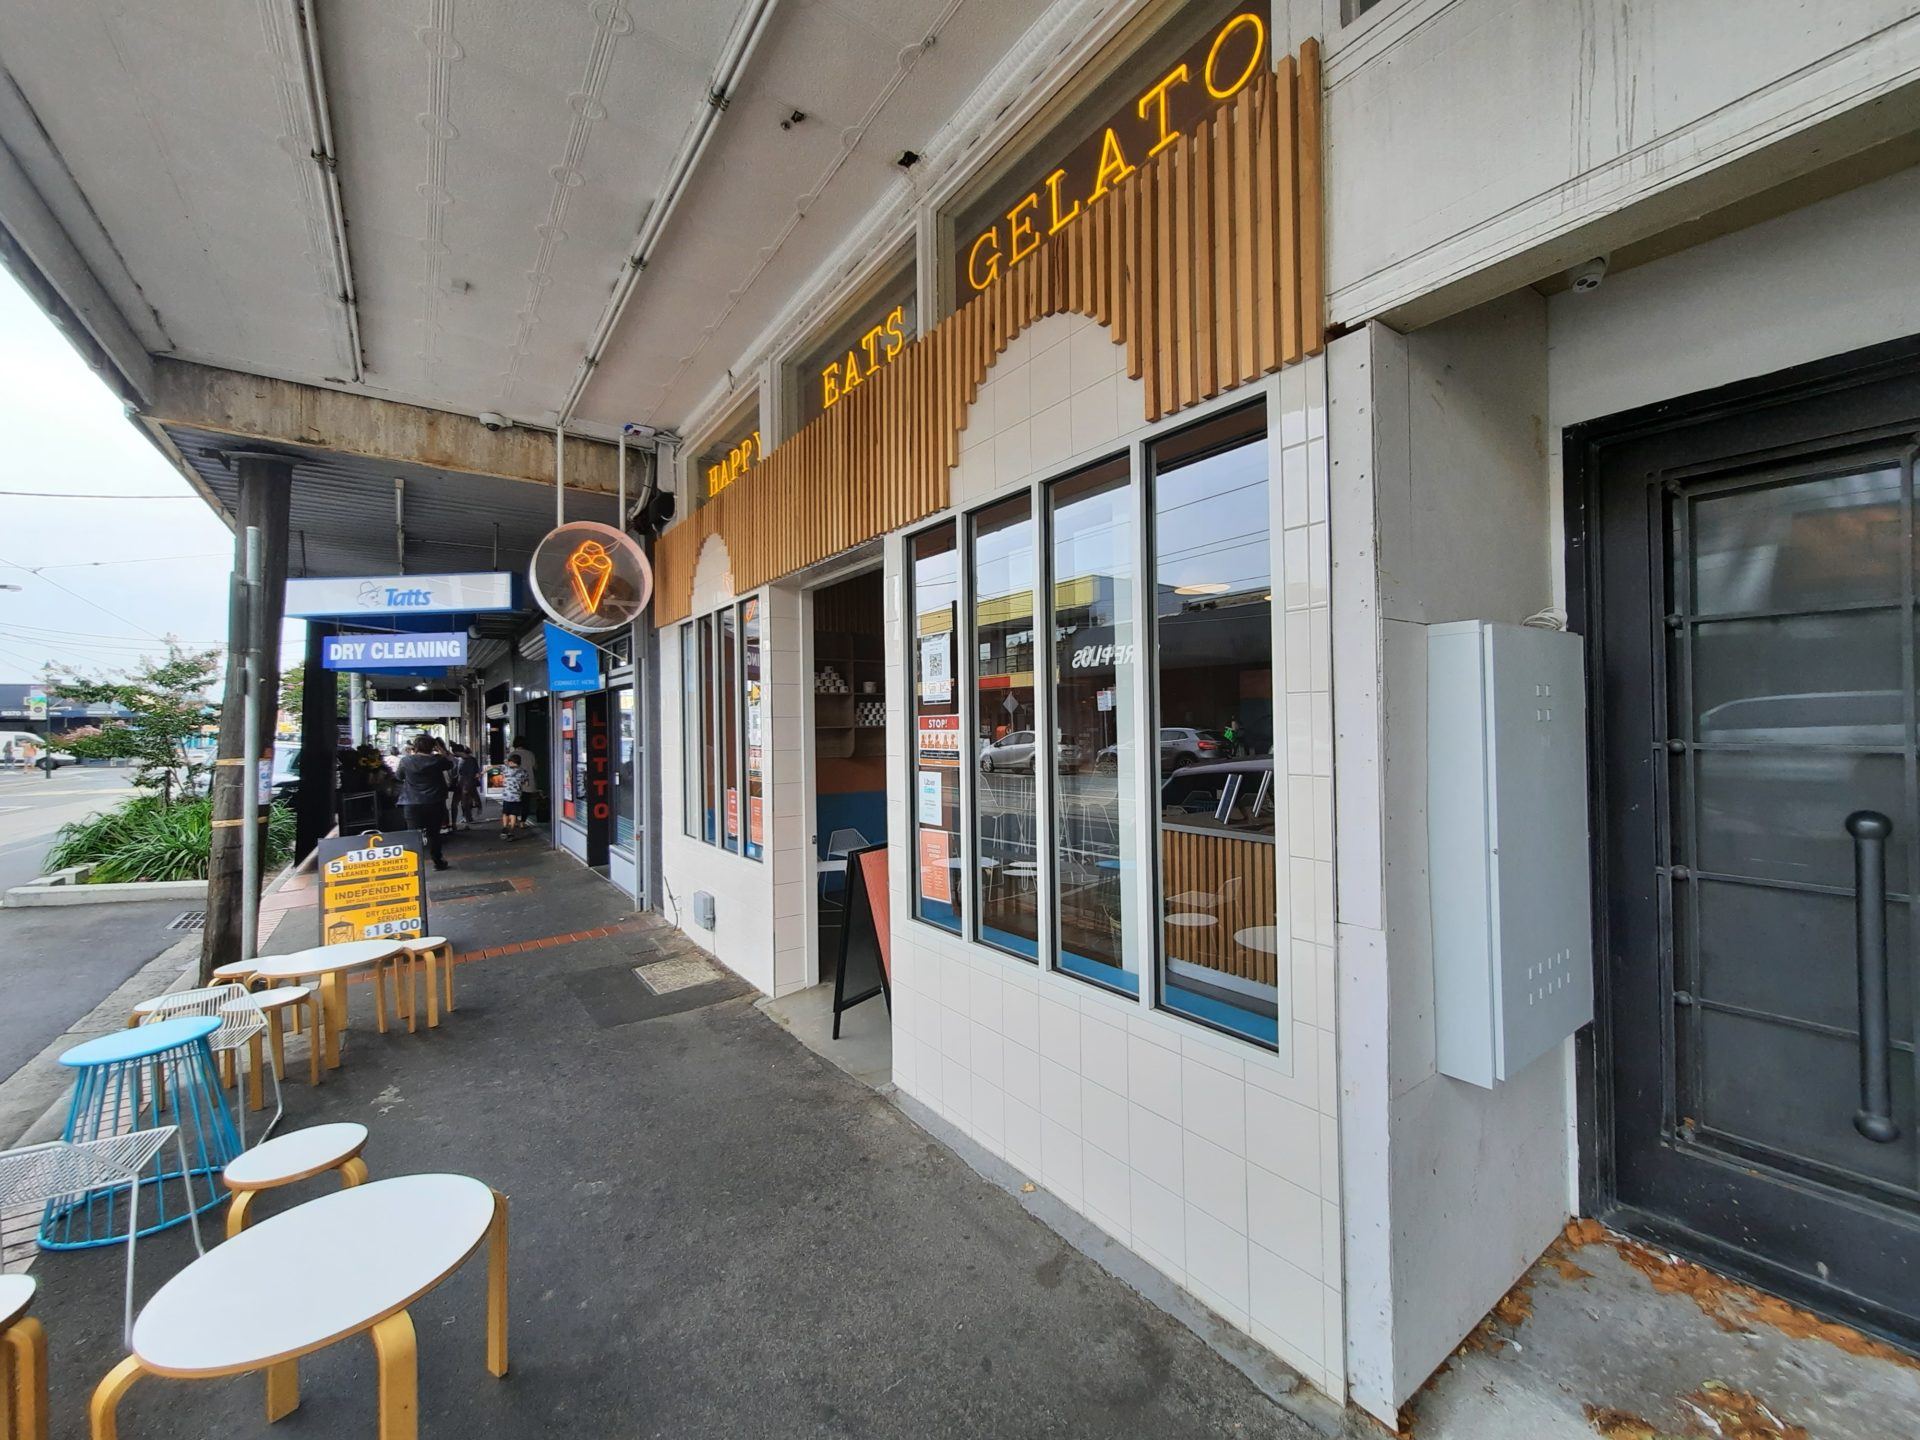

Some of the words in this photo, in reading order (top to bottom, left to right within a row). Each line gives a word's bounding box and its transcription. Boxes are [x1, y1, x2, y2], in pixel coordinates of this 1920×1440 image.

[822, 305, 903, 409] EATS
[968, 13, 1265, 290] GELATO
[385, 588, 433, 606] Tatts
[330, 643, 368, 661] DRY
[371, 640, 461, 659] CLEANING
[928, 719, 948, 728] STOP!
[591, 711, 609, 819] LOTTO
[348, 847, 402, 862] $16.50
[330, 862, 342, 873] 5
[343, 862, 380, 871] BUSINESS
[382, 858, 409, 866] SHIRTS
[336, 870, 370, 878] CLEANED
[378, 865, 409, 873] PRESSED
[334, 883, 411, 900] INDEPENDENT
[377, 912, 407, 922] SERVICE
[382, 904, 417, 915] CLEANING
[366, 918, 419, 936] $18.00
